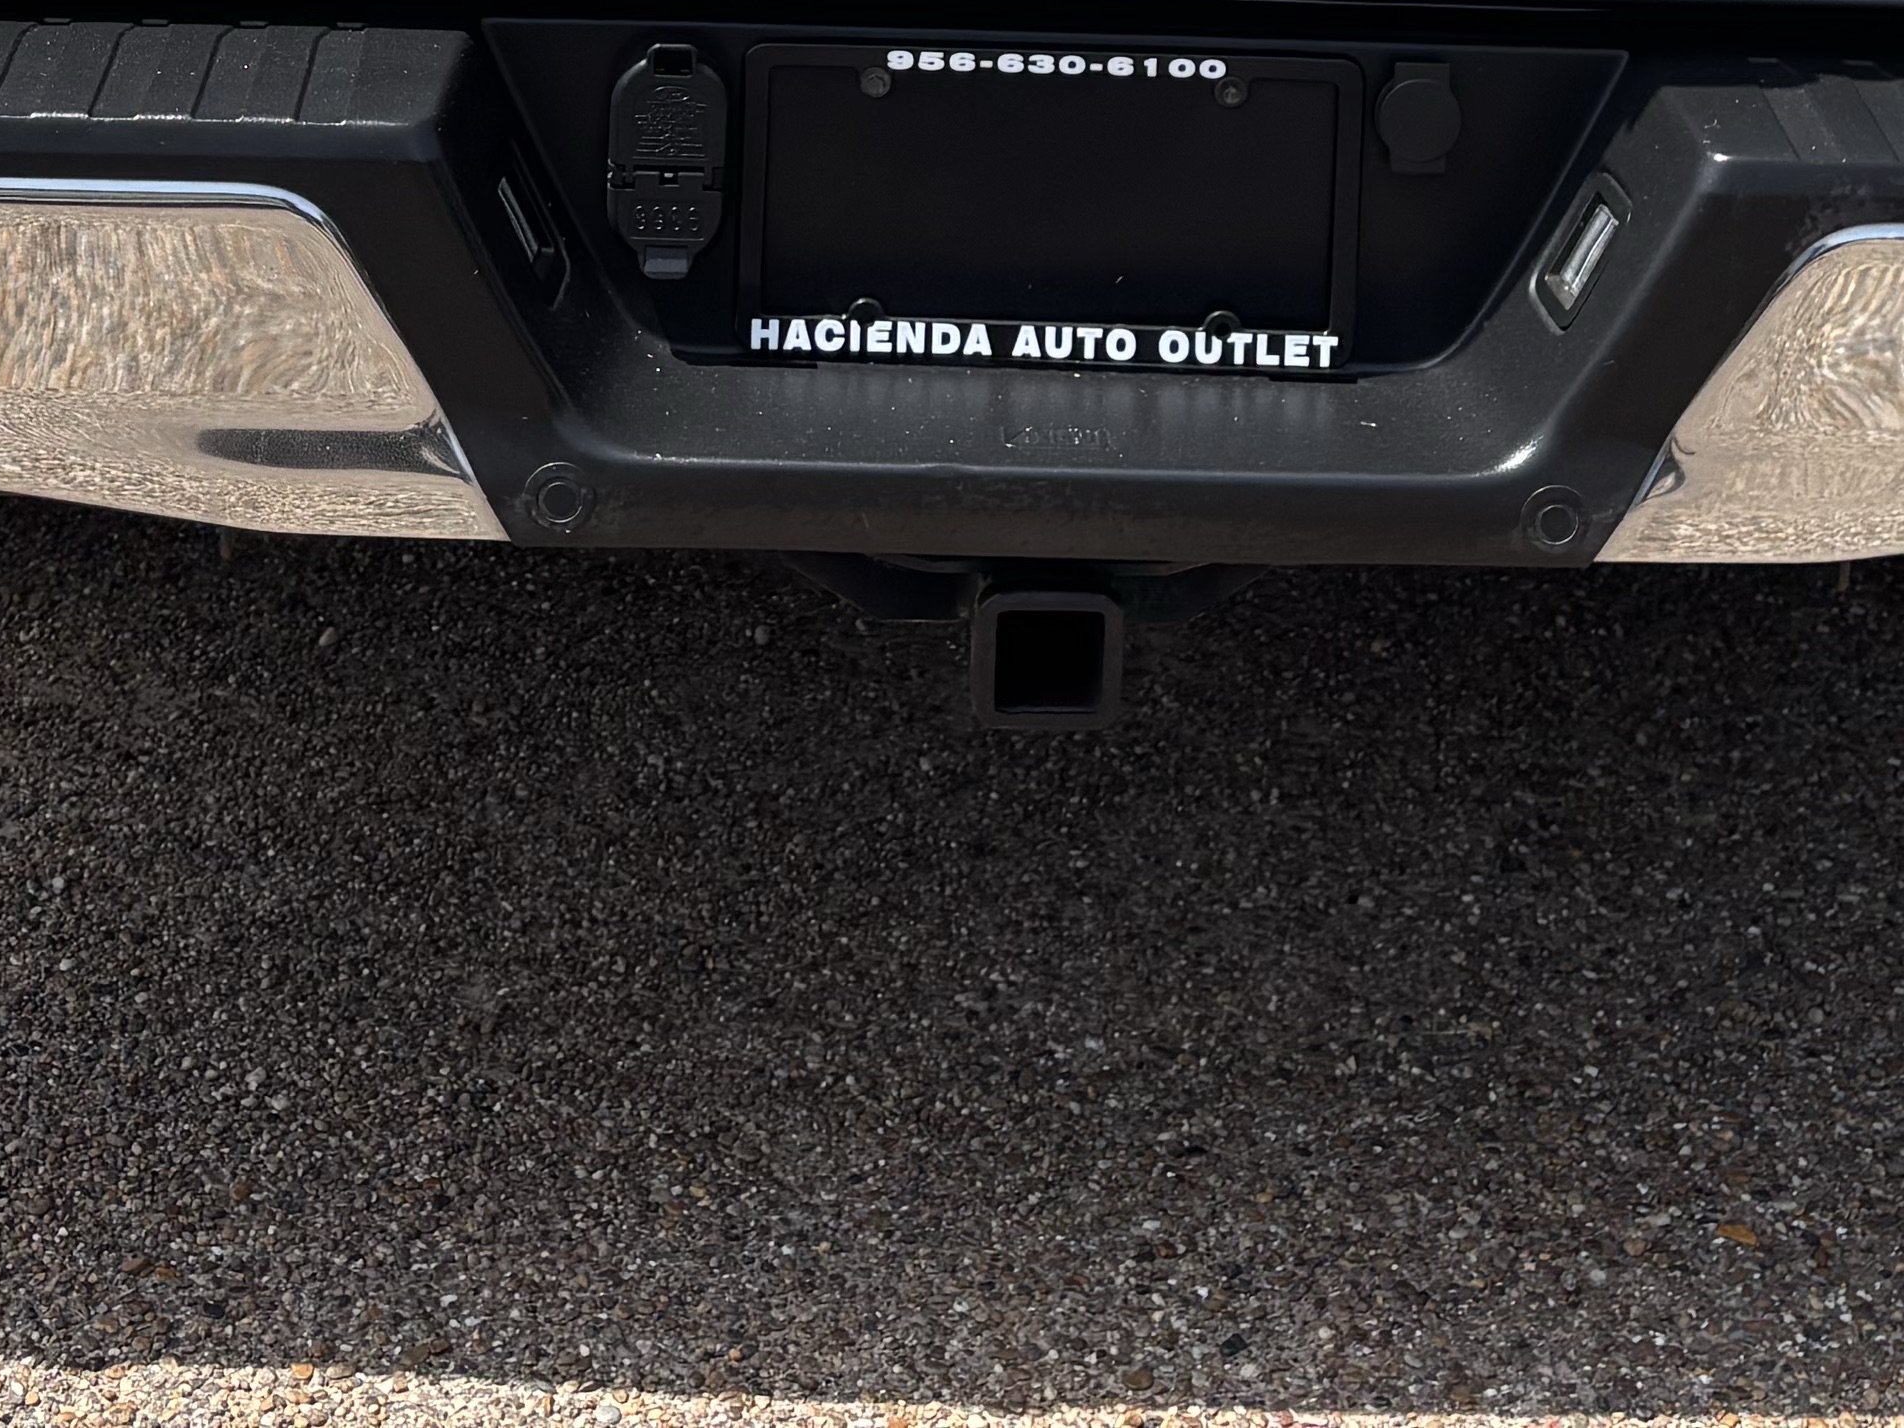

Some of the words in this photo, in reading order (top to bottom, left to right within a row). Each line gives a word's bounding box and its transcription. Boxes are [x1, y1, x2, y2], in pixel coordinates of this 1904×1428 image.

[885, 50, 1228, 80] 956-630-6100
[749, 317, 994, 358] HACIENDA
[1011, 324, 1138, 363] AUTO
[1157, 329, 1340, 369] OUTLET
